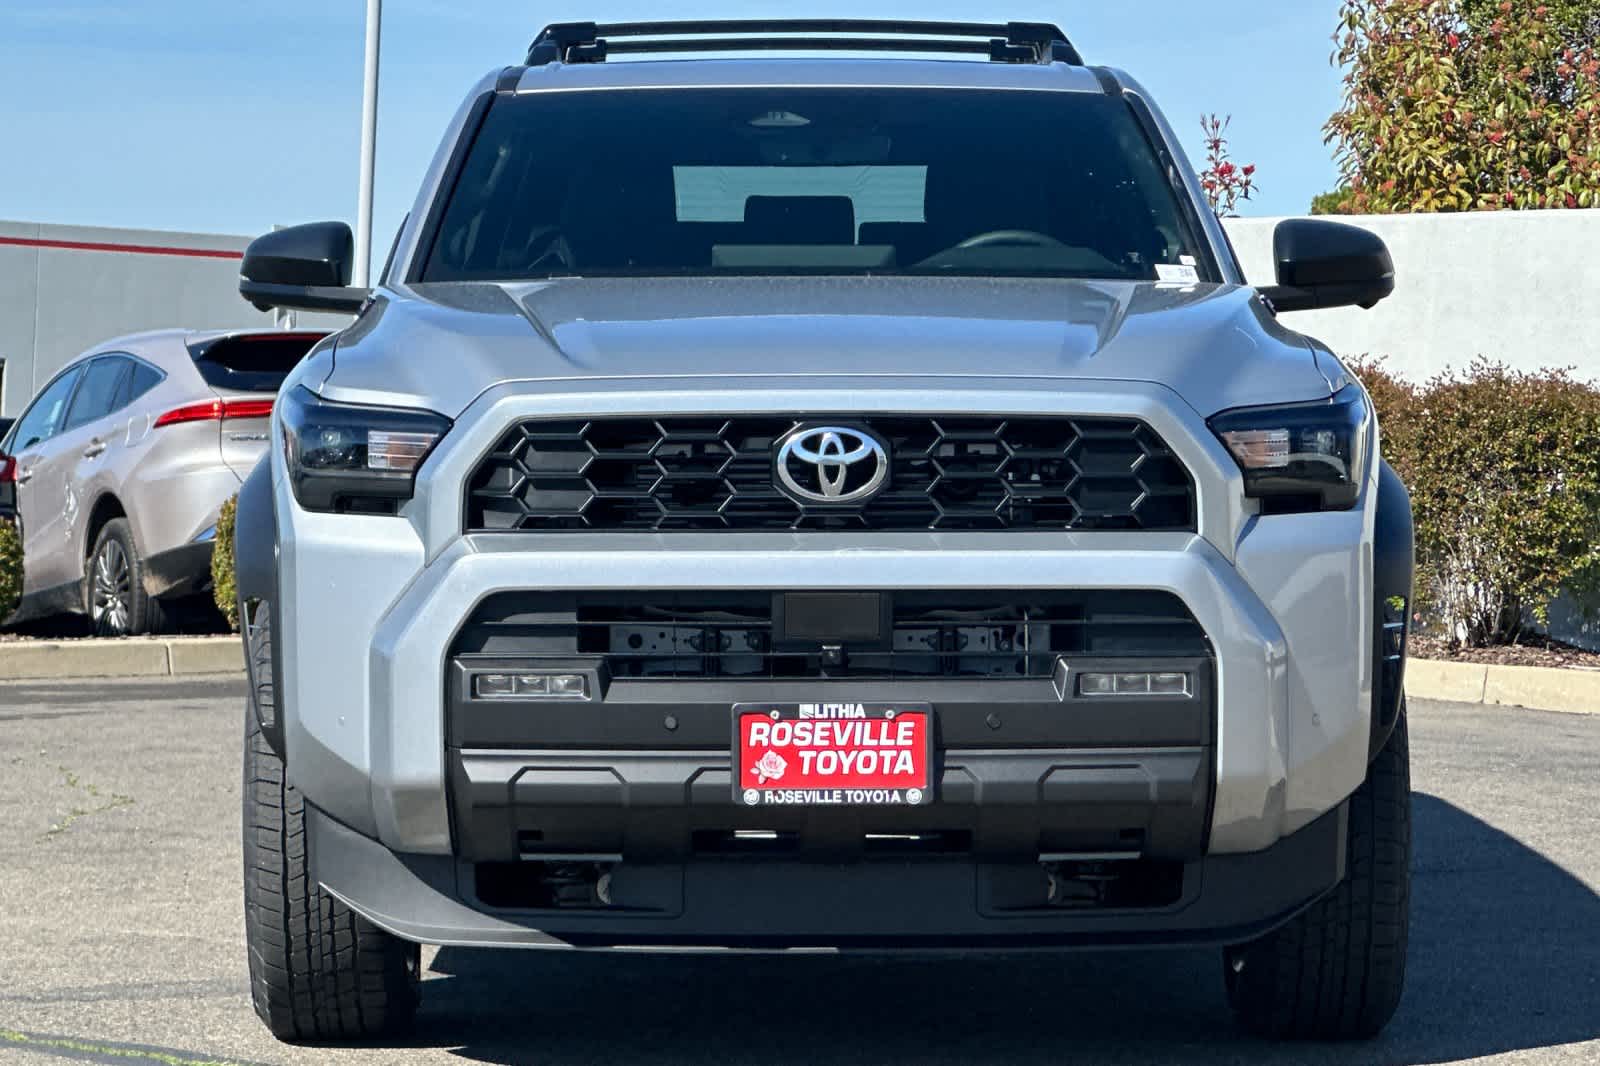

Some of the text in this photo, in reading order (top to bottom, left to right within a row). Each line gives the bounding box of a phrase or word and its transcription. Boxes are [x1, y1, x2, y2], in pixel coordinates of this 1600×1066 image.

[815, 704, 866, 719] LITHIA
[750, 721, 915, 747] ROSEVILLE
[799, 750, 915, 775] TOYOTA
[764, 790, 901, 803] ROSEVILLE TOYOTA
